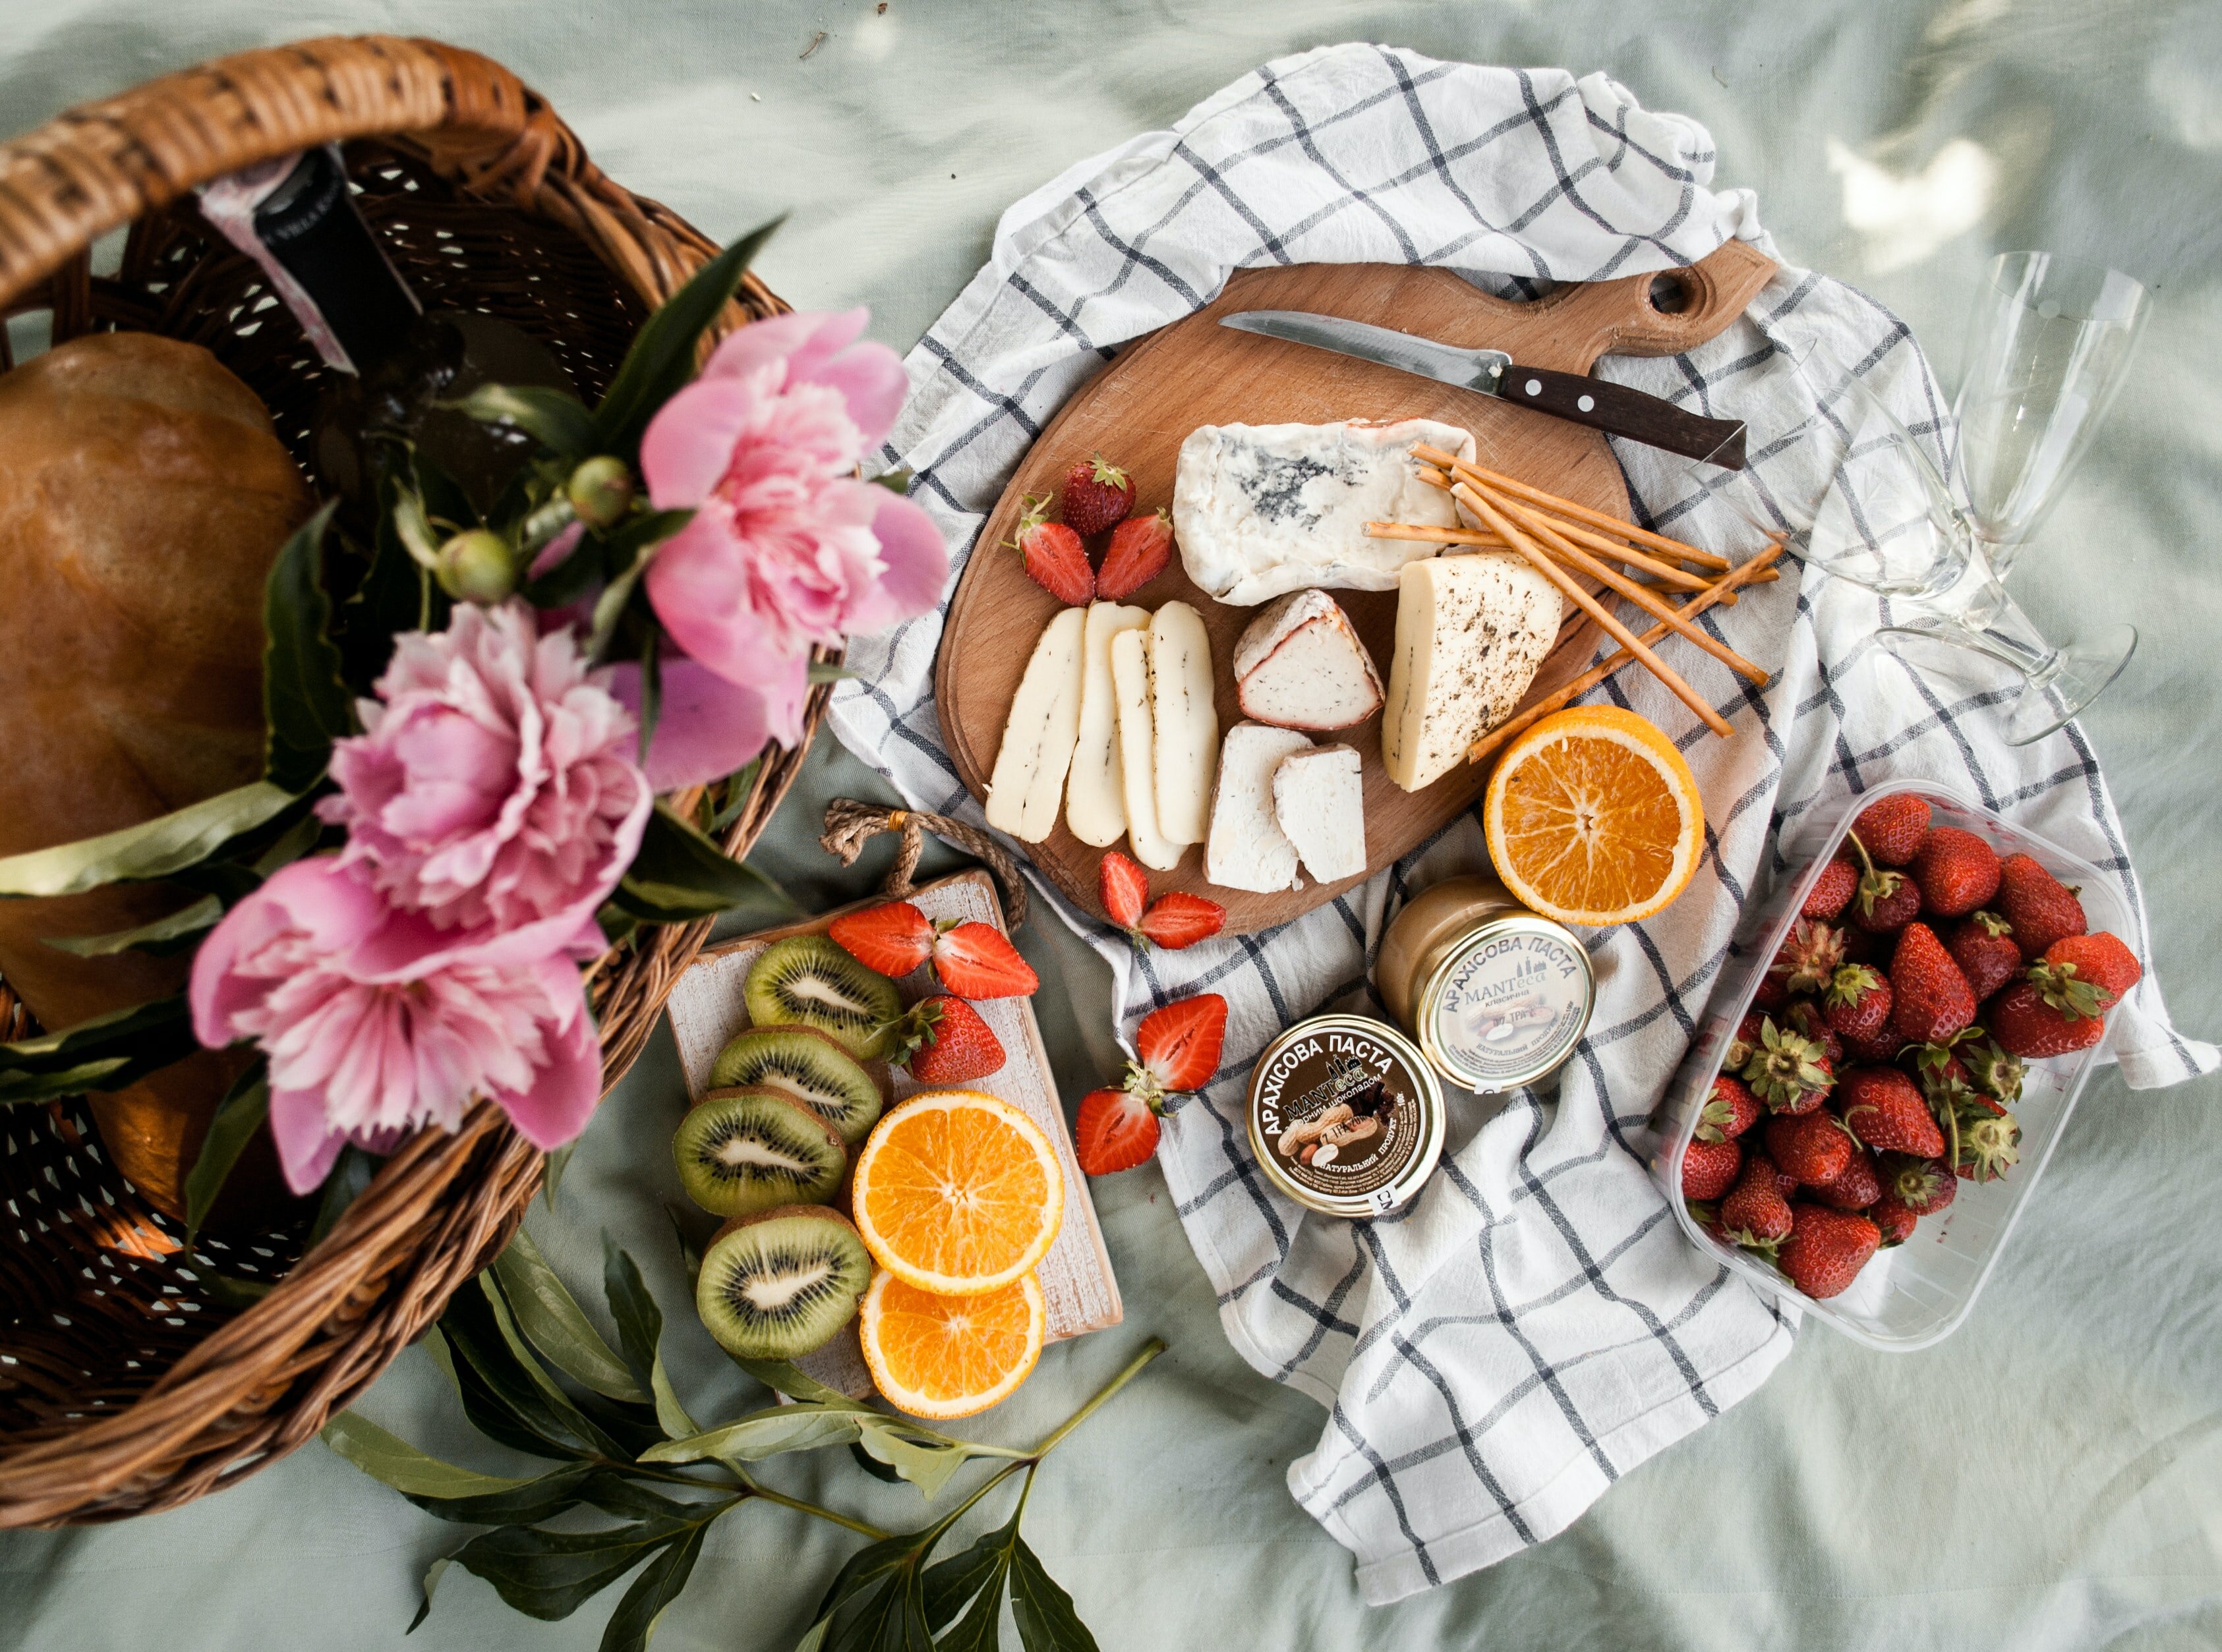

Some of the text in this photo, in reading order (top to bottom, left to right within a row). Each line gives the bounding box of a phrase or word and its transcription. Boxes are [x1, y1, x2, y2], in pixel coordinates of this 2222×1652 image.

[1443, 936, 1577, 1013] АРАХІСОВА ПАСТА
[1465, 972, 1547, 1005] MANTeca
[1484, 988, 1530, 1008] класична
[1476, 1042, 1529, 1057] НАТУРАЛЬНИЙ
[1262, 1038, 1323, 1135] АРАХІСОВА
[1329, 1035, 1394, 1075] ПАСТА
[1283, 1066, 1369, 1122] MANTeca
[1328, 1073, 1382, 1108] шоколадом
[1320, 1118, 1397, 1174] НАТУРАЛЬНИЙ ПРОДУКТ
